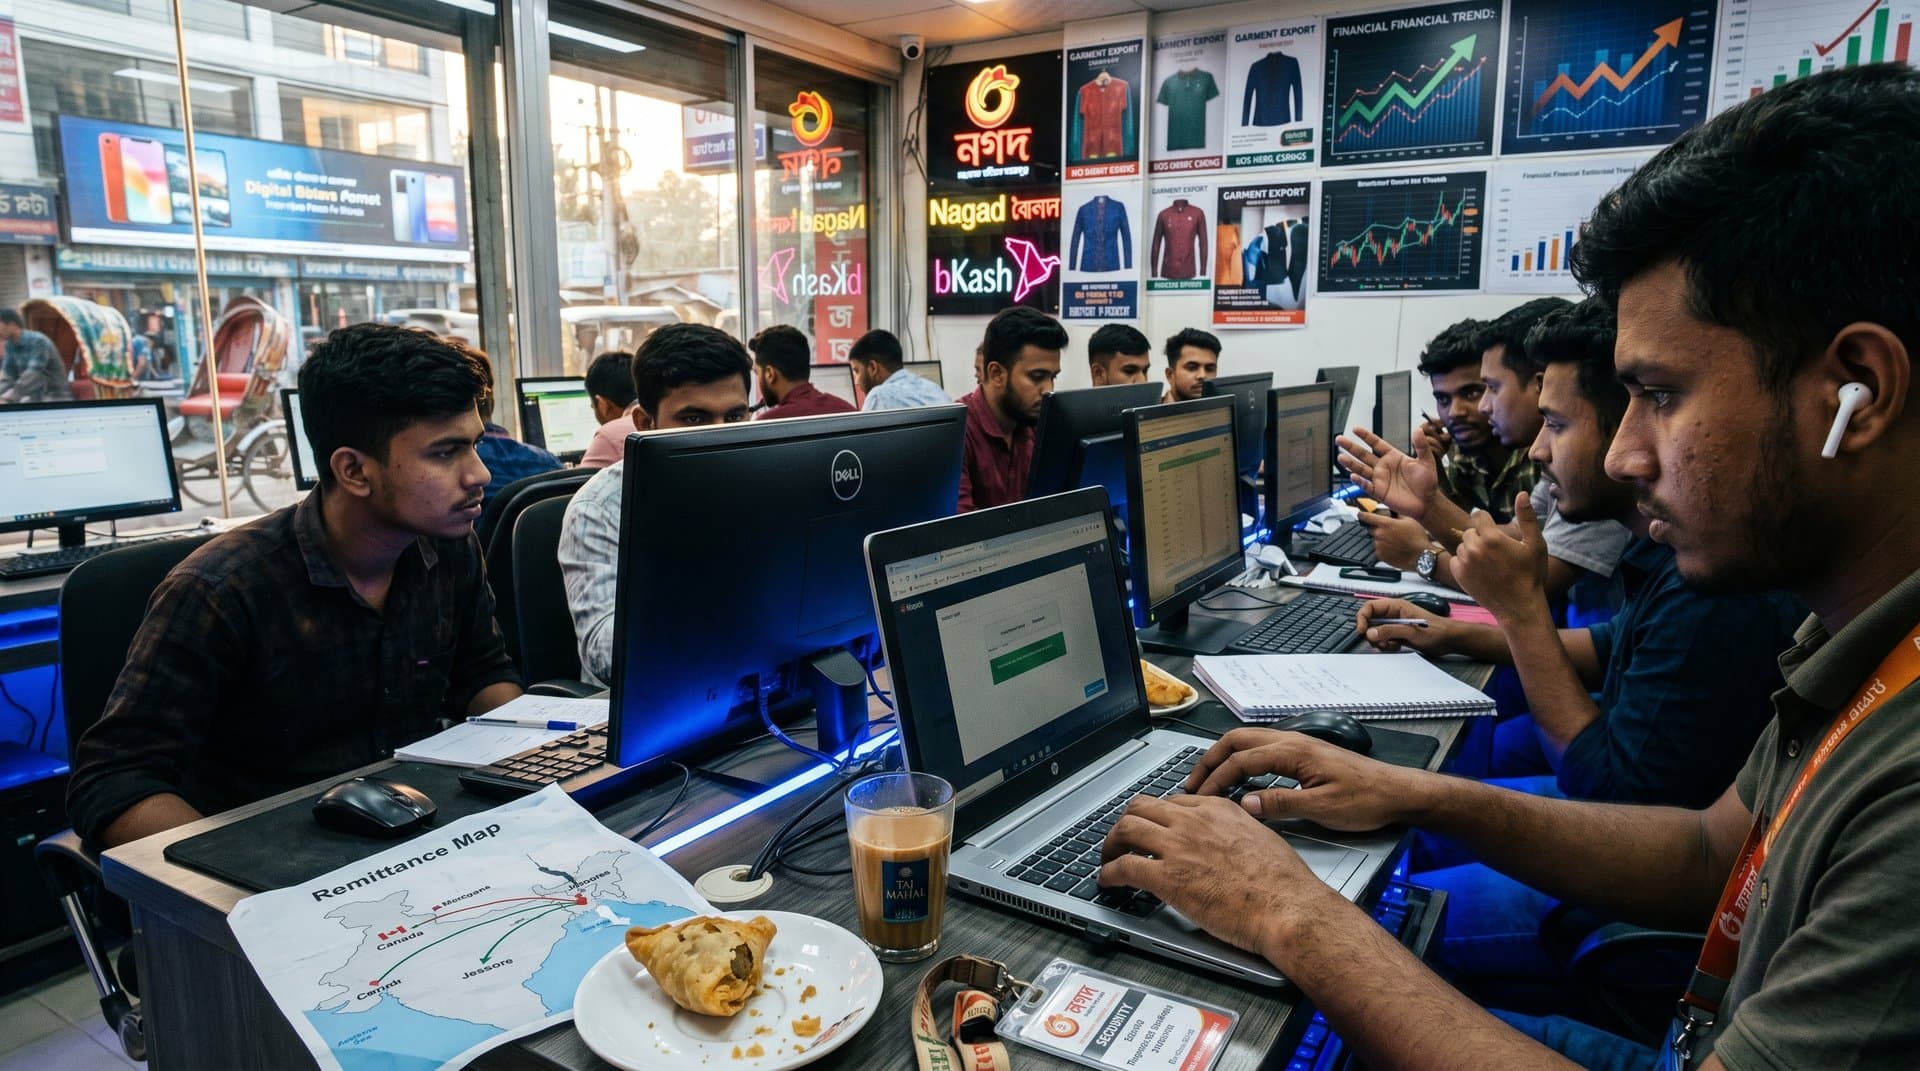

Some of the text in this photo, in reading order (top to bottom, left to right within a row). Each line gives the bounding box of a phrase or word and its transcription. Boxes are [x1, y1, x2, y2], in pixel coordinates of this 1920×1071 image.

[1235, 25, 1316, 43] GARMENT EXPORT
[1333, 22, 1388, 37] FINANCIAL
[1391, 15, 1449, 31] FINANCIAL
[1193, 34, 1226, 46] EXPORT
[1069, 44, 1140, 61] GARMENT EXPORT
[954, 127, 1033, 167] নগদ
[1152, 185, 1208, 195] GARMENT EXPORT
[1223, 187, 1306, 200] GARMENT EXPORT
[929, 194, 1006, 231] Nagad
[935, 257, 1012, 294] bKash
[834, 467, 860, 483] DELL
[312, 822, 501, 902] Remittance Map
[886, 887, 927, 900] MAHAL
[895, 879, 914, 890] TAJ
[376, 930, 425, 951] Canada
[461, 957, 514, 980] Jessore
